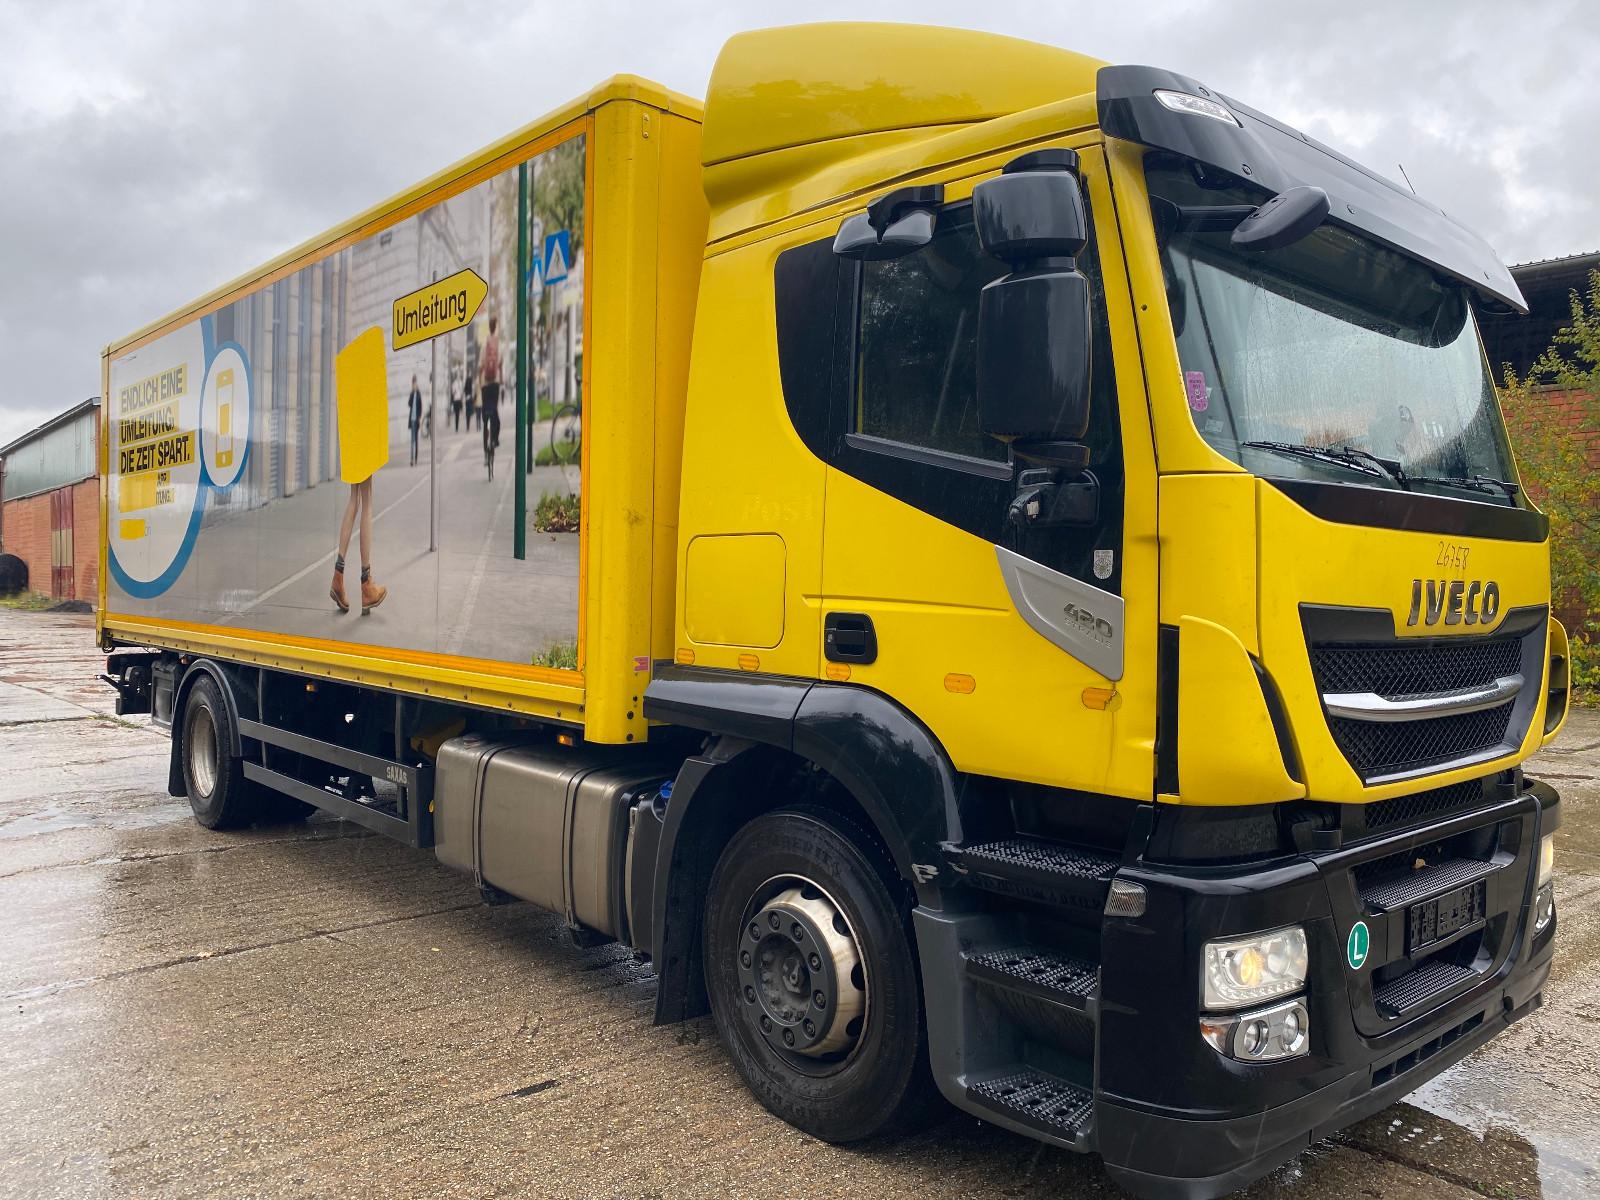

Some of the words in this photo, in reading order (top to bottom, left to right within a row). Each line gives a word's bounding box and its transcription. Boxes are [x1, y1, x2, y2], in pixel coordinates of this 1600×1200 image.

[396, 289, 467, 336] Umleitung
[121, 377, 158, 413] ENDLICH
[160, 368, 182, 400] EINE
[121, 450, 134, 474] DIE
[137, 444, 156, 470] ZEIT
[158, 436, 190, 466] SPART.
[1436, 541, 1470, 570] 26758
[1064, 603, 1112, 638] 420
[1407, 579, 1500, 626] IVECO
[386, 765, 408, 784] SAXAS
[1354, 931, 1364, 960] L
